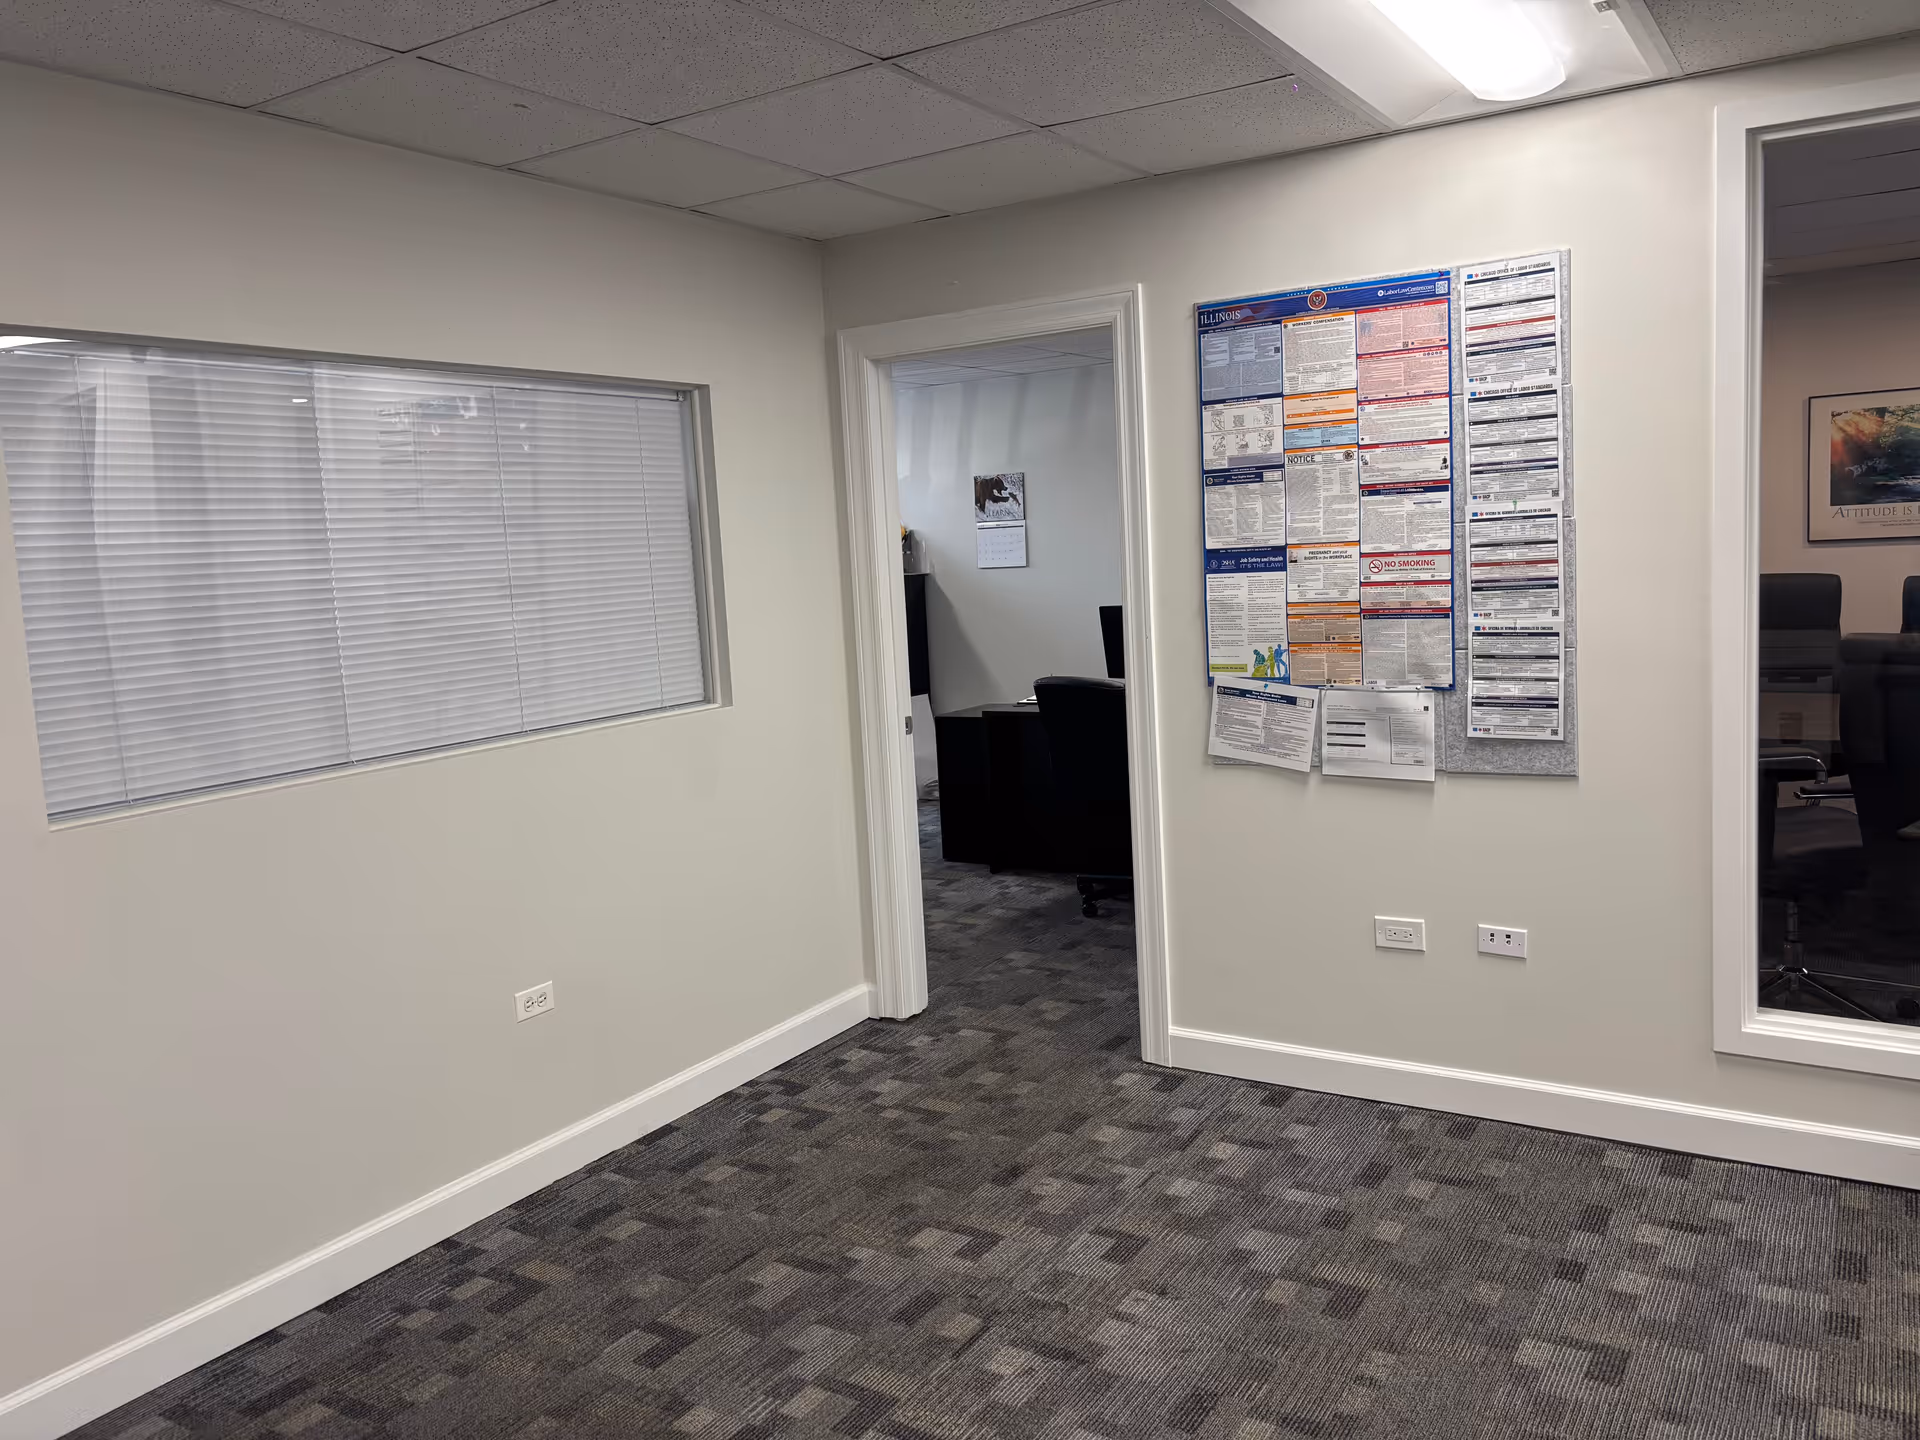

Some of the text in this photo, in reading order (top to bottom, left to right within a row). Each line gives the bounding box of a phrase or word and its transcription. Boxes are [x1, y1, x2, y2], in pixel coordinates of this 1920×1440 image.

[1480, 270, 1496, 278] CHICAGO
[1528, 261, 1551, 270] STANDARDS
[1200, 310, 1240, 325] ILLINOIS
[1314, 316, 1344, 326] COMPENSATION
[1287, 455, 1316, 464] NOTICE
[1384, 559, 1436, 568] NO SMOKING
